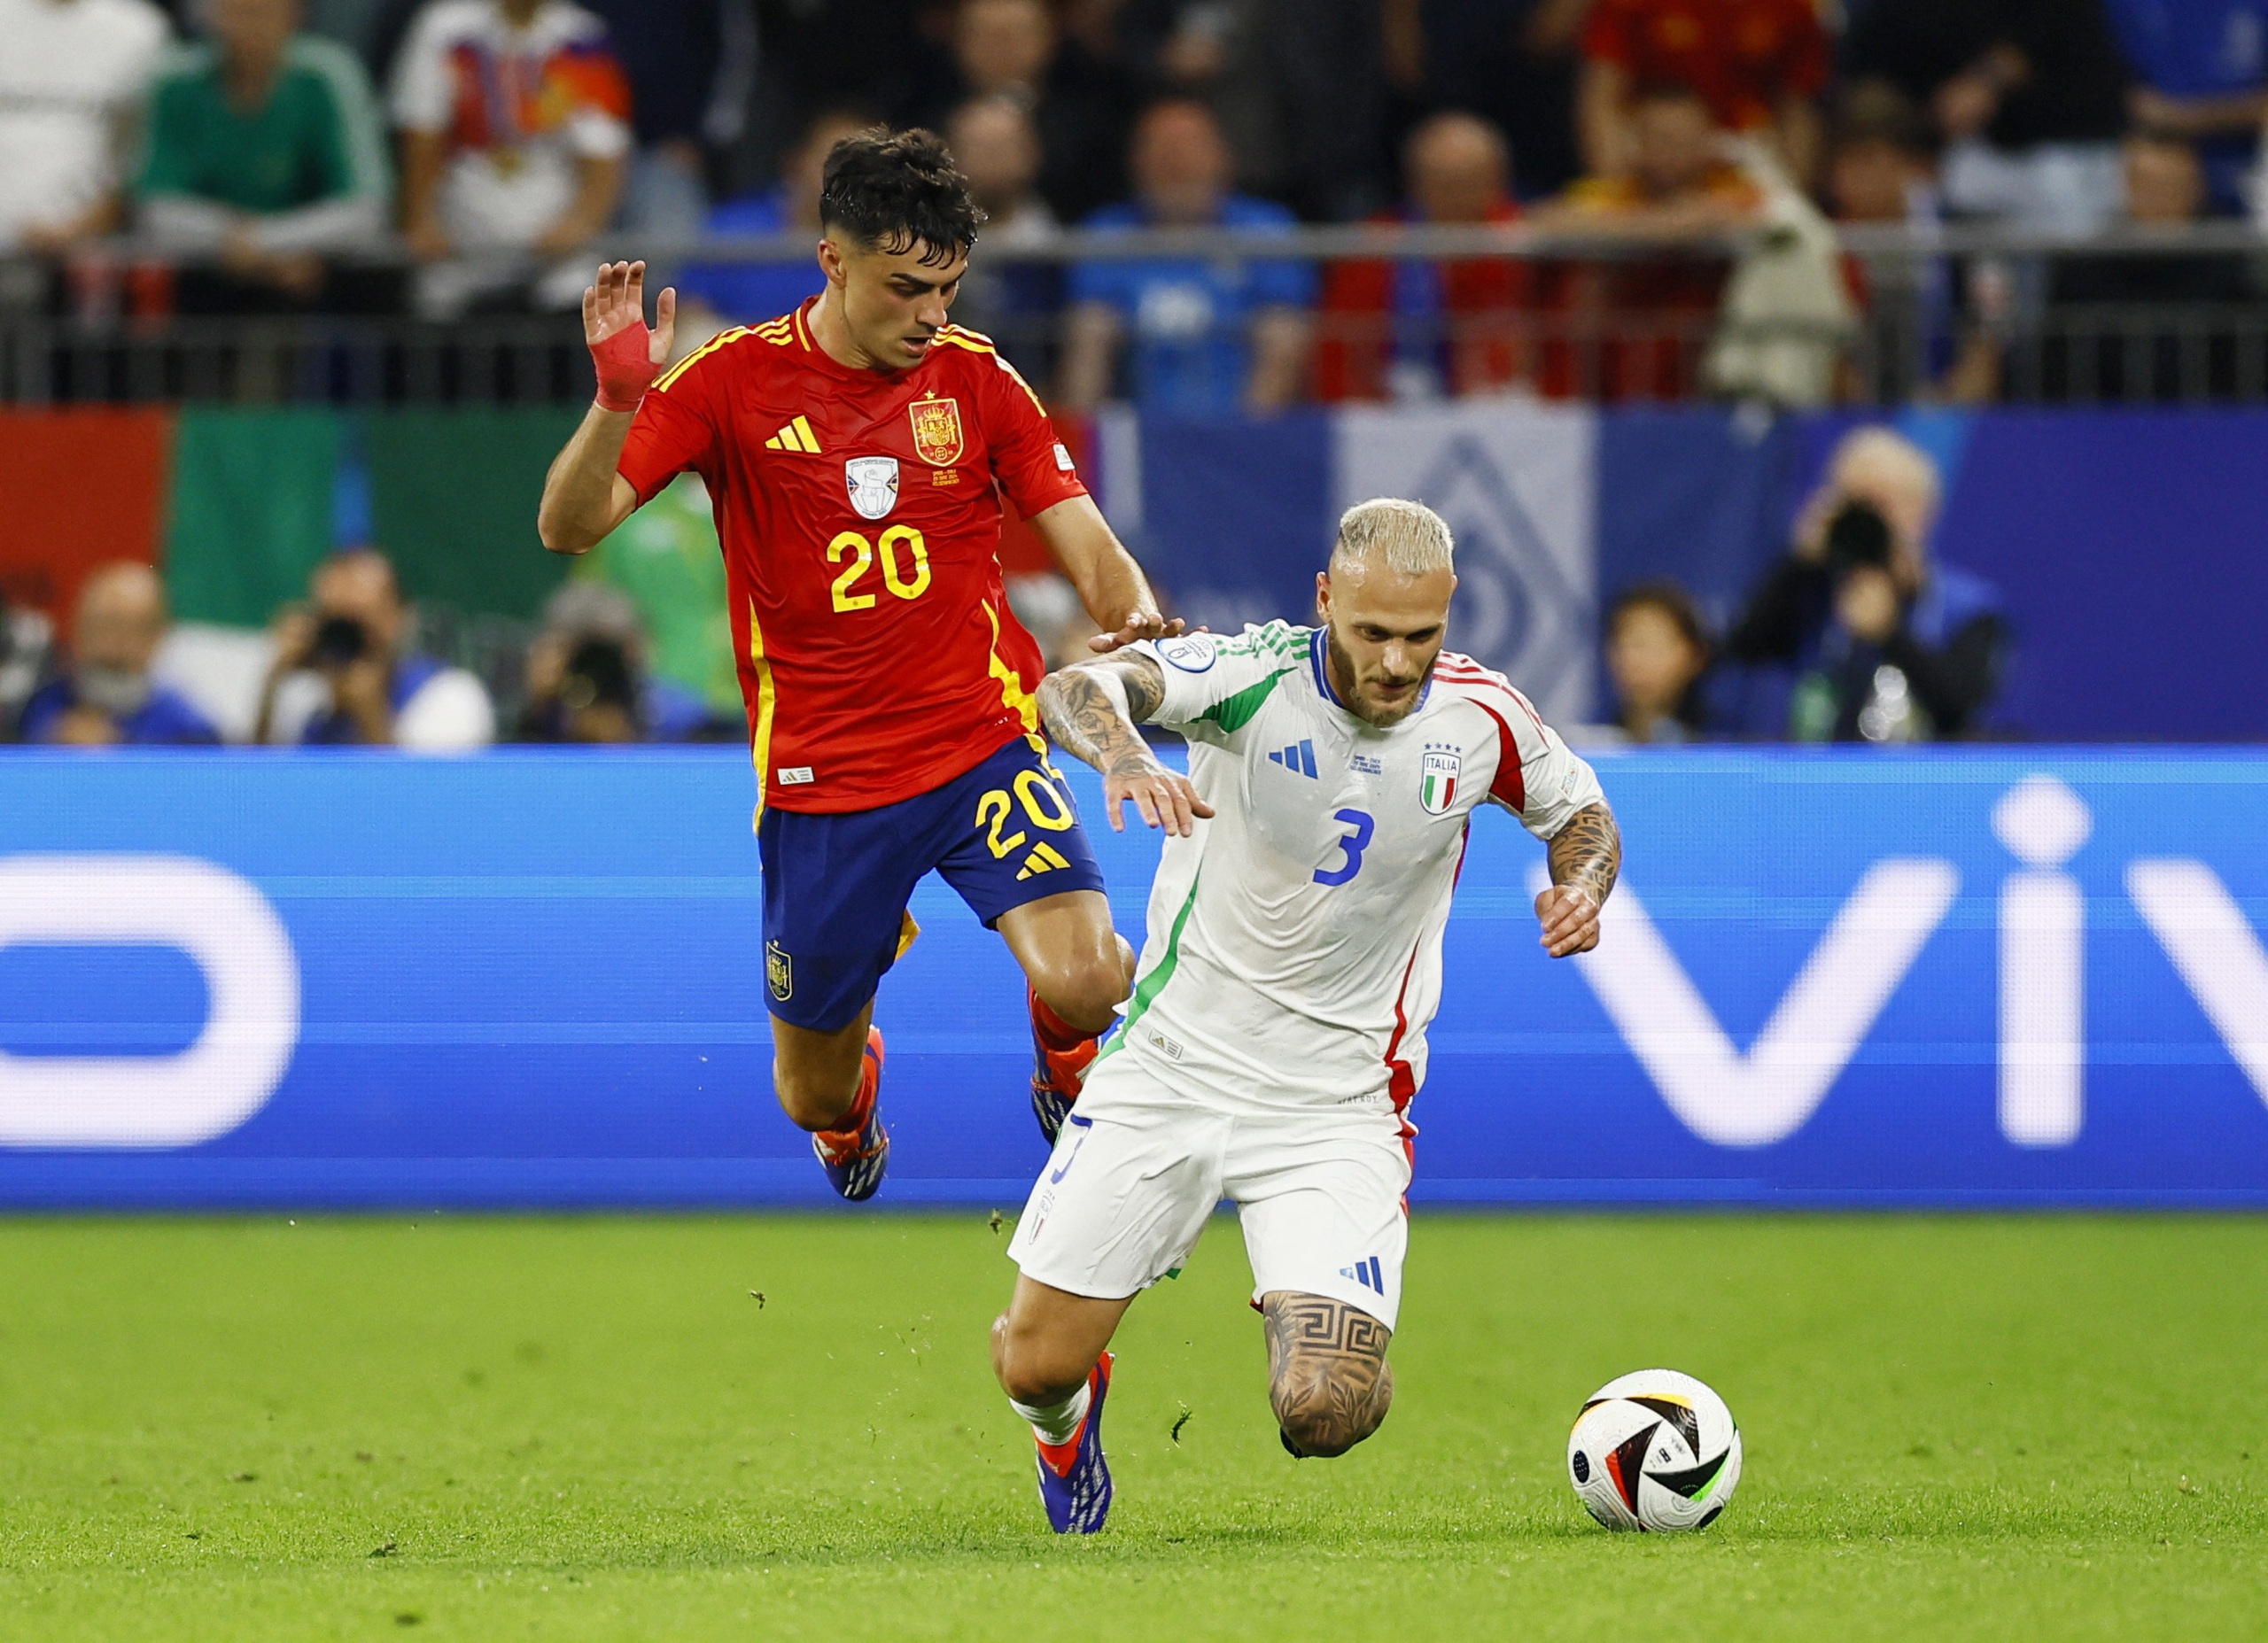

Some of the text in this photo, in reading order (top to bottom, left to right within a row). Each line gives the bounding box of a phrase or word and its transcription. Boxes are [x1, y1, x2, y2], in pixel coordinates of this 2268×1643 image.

[827, 524, 931, 613] 20
[1426, 757, 1457, 771] ITALIA
[975, 769, 1074, 859] 20
[1312, 808, 1375, 887] 3
